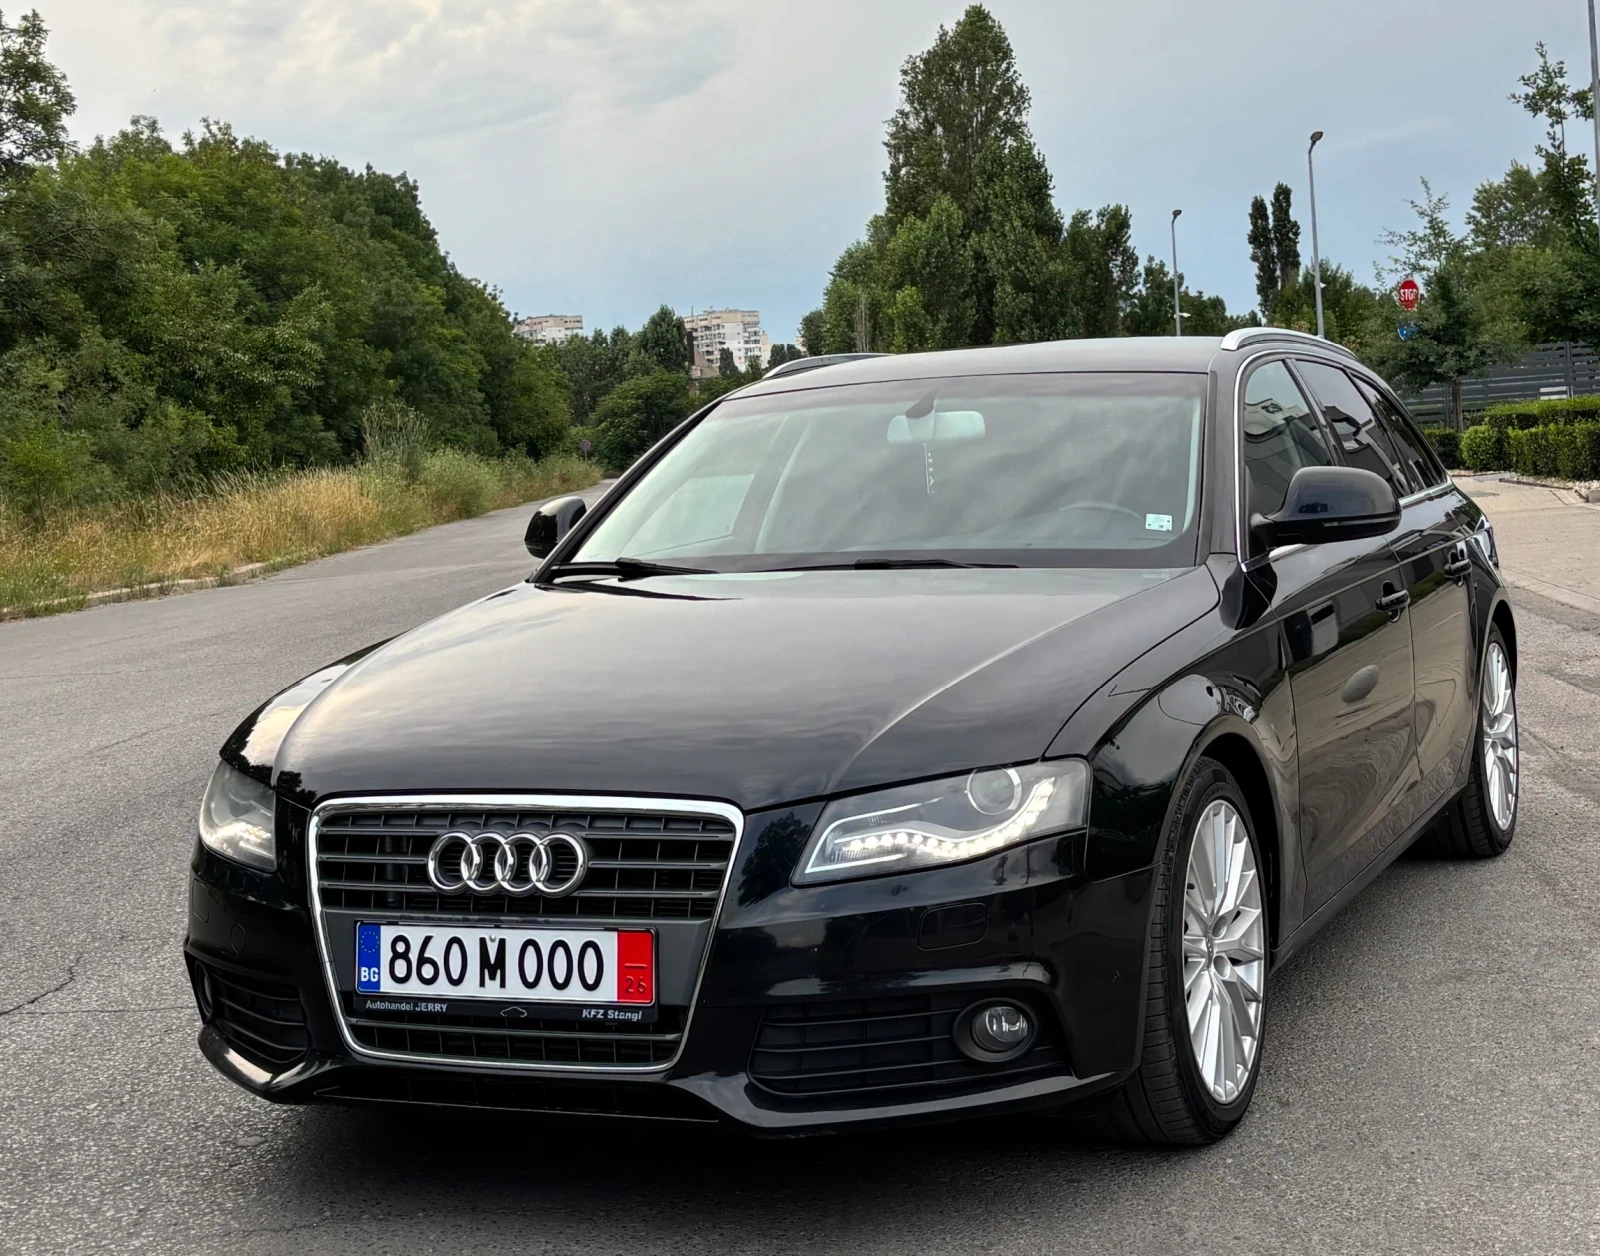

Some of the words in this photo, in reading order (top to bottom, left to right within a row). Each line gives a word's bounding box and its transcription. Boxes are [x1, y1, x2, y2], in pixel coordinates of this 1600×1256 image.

[389, 934, 468, 987] 860
[479, 937, 506, 989] M
[518, 938, 604, 991] 000
[361, 967, 379, 982] BG
[625, 975, 647, 994] 26
[365, 1000, 413, 1011] Autohandel
[415, 1003, 448, 1012] JERRY
[582, 1009, 605, 1019] KFZ
[607, 1009, 642, 1022] Stangl
